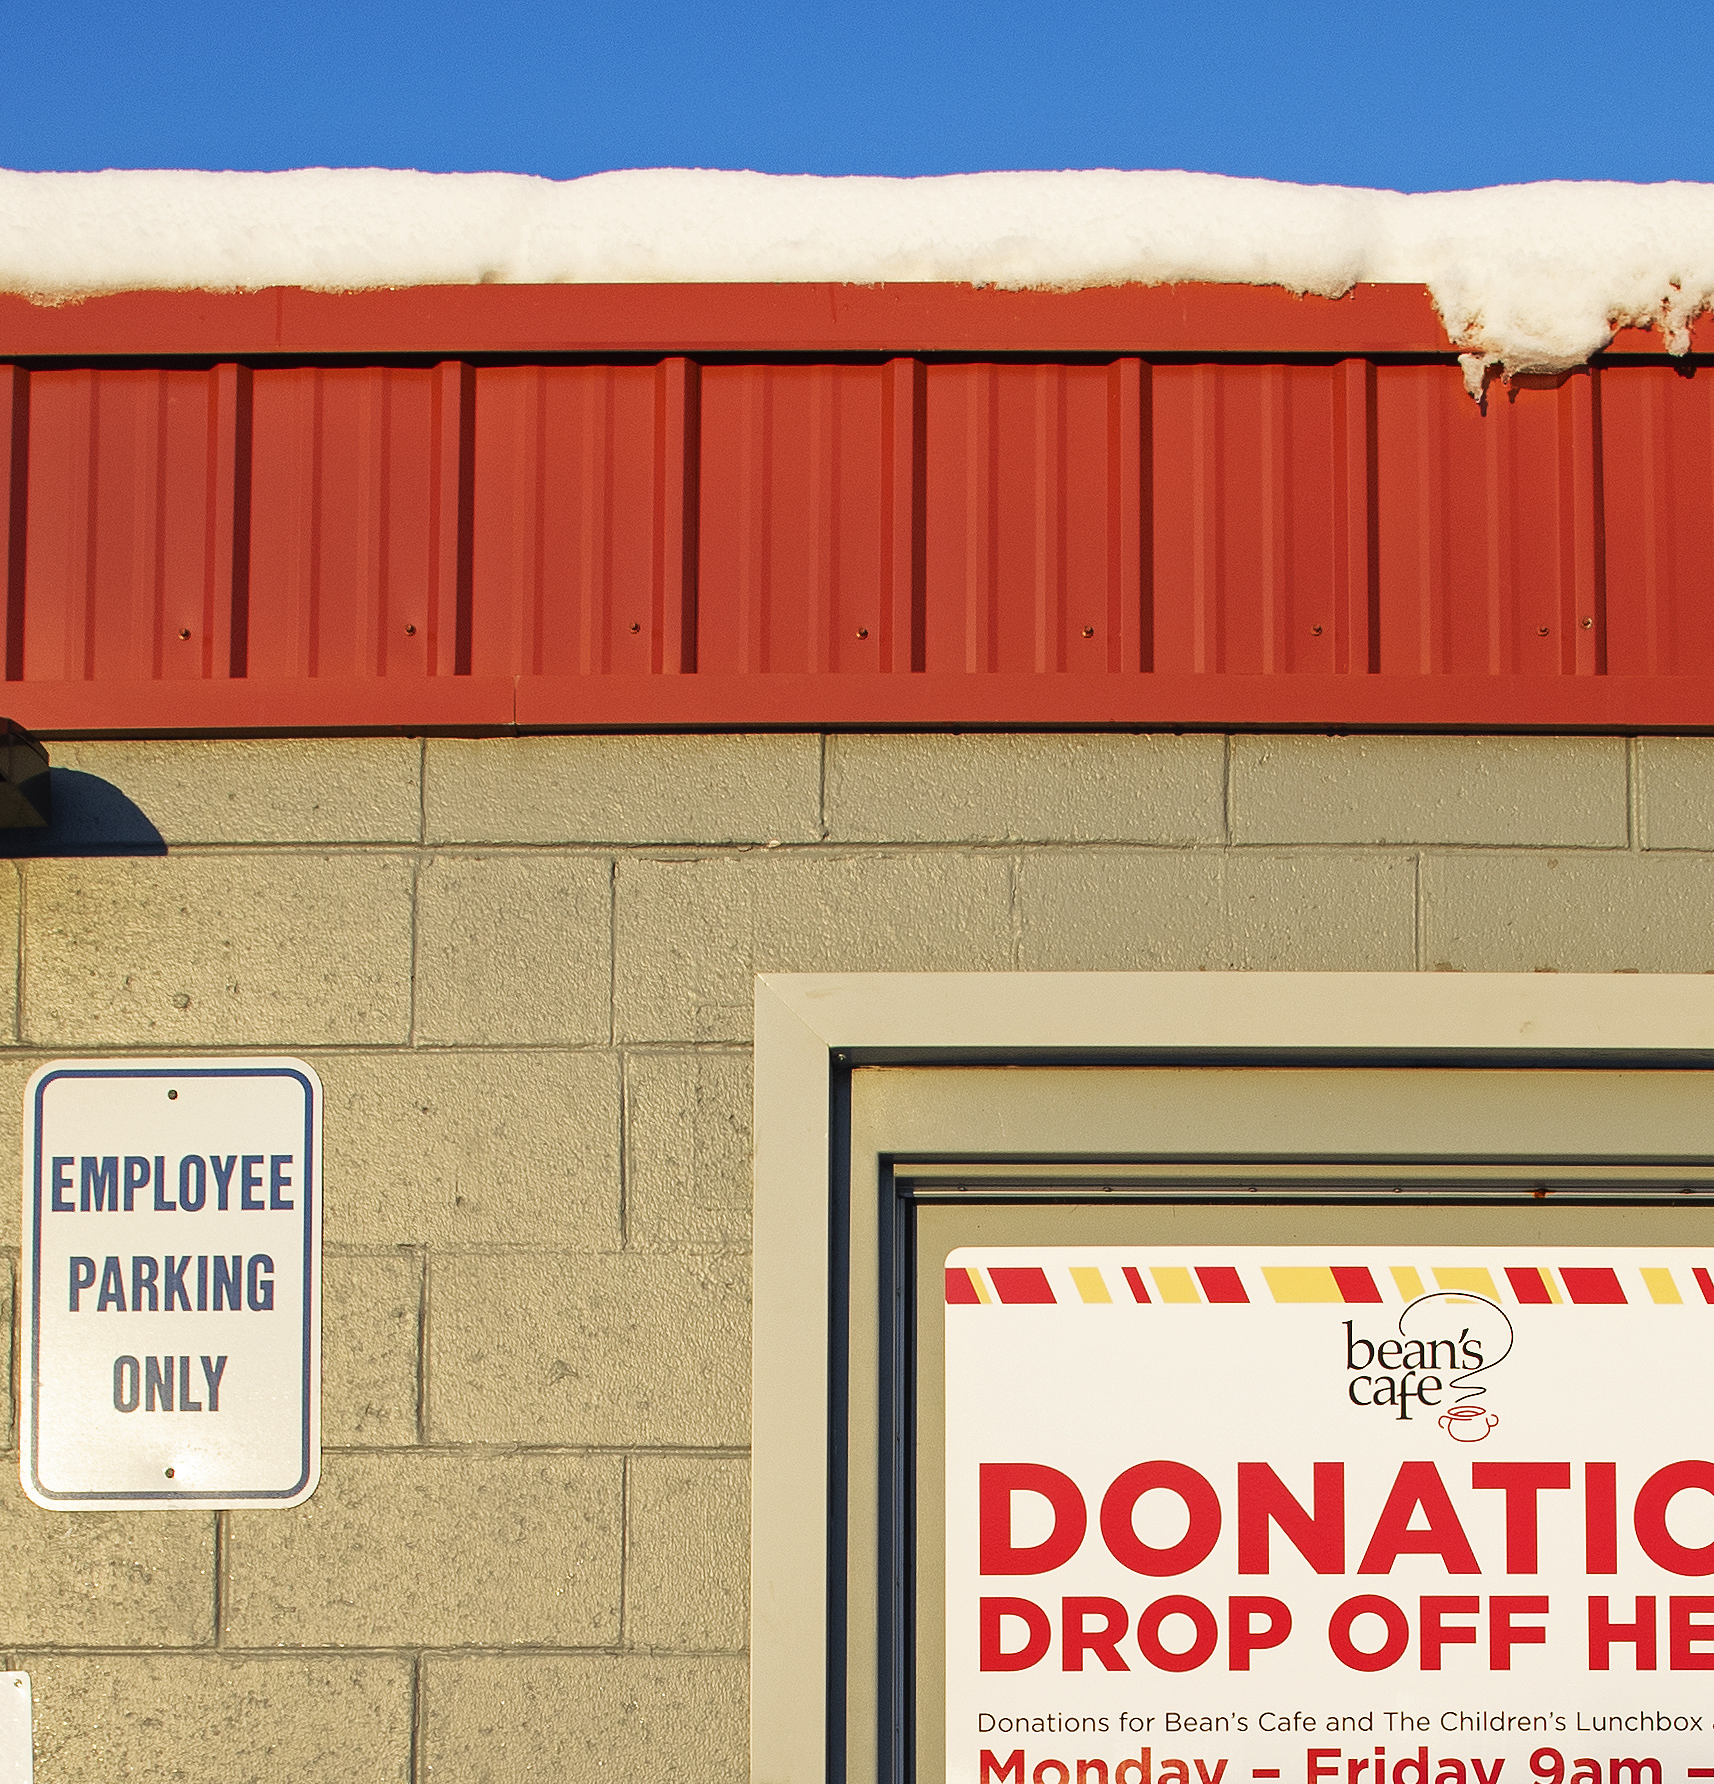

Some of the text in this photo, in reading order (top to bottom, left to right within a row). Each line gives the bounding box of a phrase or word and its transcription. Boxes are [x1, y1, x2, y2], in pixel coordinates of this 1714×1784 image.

[51, 1154, 295, 1213] EMPLOYEE
[68, 1253, 276, 1313] PARKING
[1342, 1319, 1484, 1371] bean's
[112, 1355, 228, 1414] ONLY
[1348, 1370, 1443, 1421] cafe
[979, 1595, 1292, 1673] DROP
[1329, 1594, 1549, 1673] OFF
[978, 1712, 1109, 1733] Donations
[1119, 1711, 1155, 1733] for
[1165, 1711, 1249, 1733] Bean's
[1258, 1711, 1317, 1732] Cafe
[1325, 1711, 1373, 1732] and
[1383, 1711, 1429, 1732] The
[1440, 1710, 1567, 1732] Children's
[1577, 1711, 1703, 1732] Lunchbox
